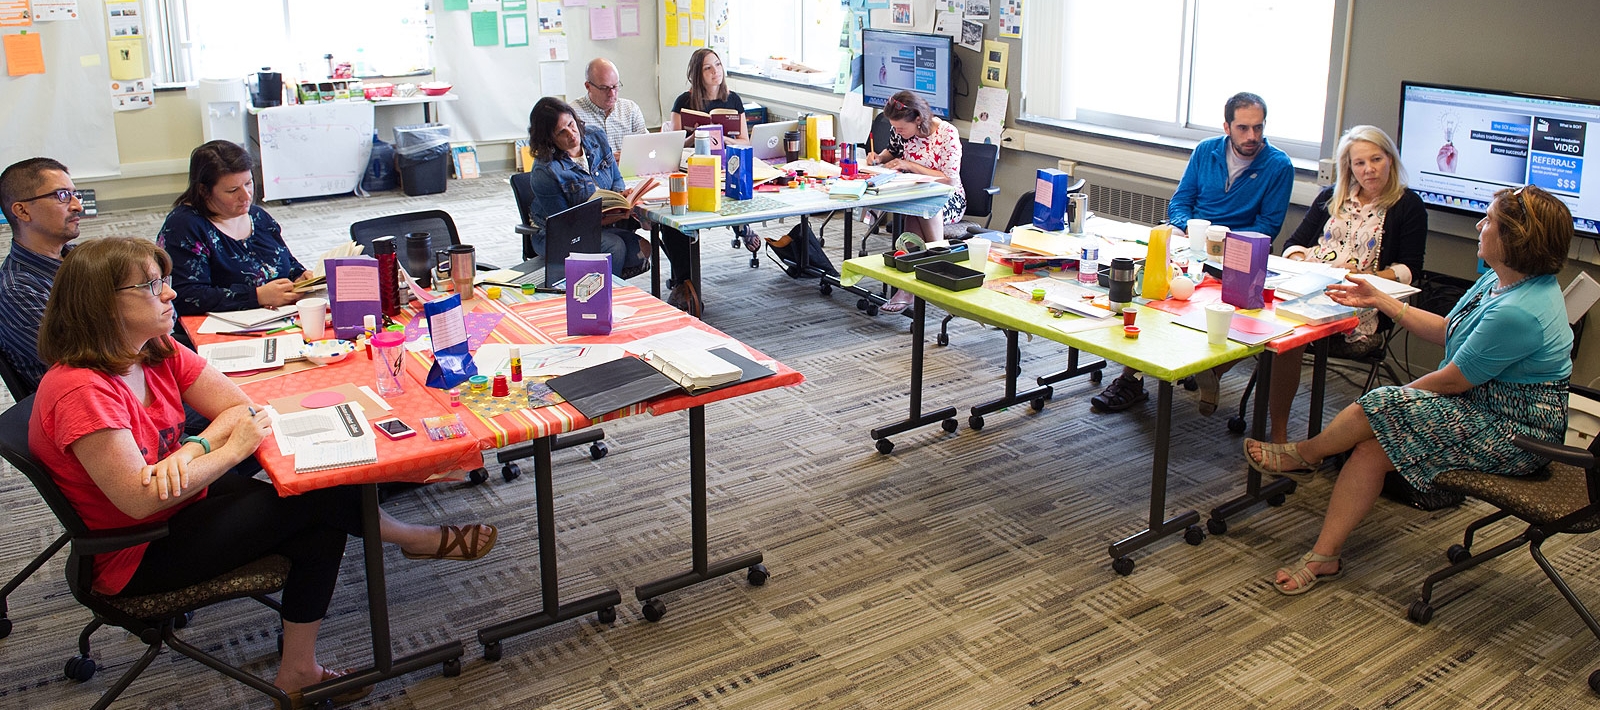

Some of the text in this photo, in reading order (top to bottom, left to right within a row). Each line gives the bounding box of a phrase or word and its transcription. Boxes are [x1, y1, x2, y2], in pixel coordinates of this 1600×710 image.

[1554, 142, 1580, 153] VIDEO
[1532, 155, 1576, 168] REFERRALS
[1556, 178, 1576, 190] $$$
